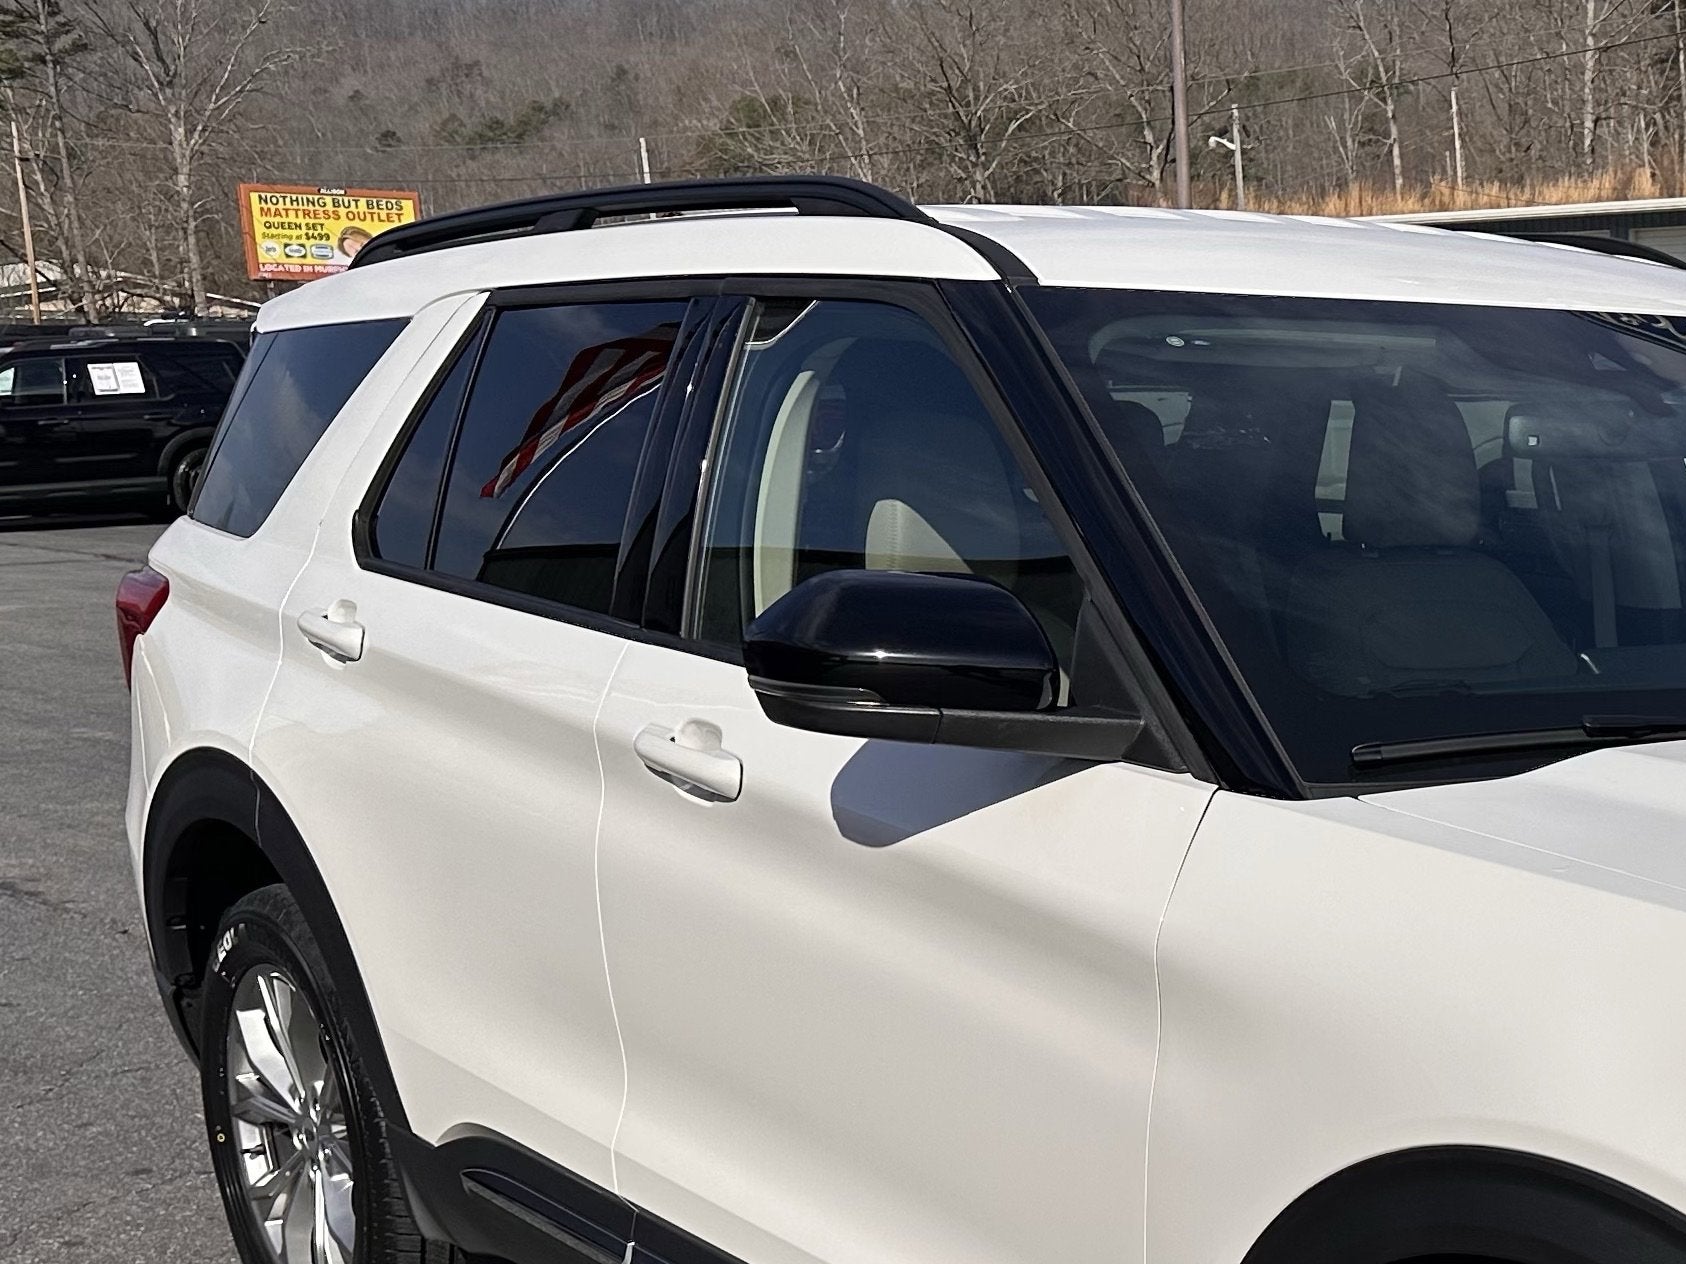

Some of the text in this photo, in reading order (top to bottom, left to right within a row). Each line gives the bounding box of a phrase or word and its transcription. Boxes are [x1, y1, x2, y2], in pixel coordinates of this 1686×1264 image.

[258, 194, 404, 211] NOTHING BUT BEDS
[260, 207, 404, 223] MATTRESS OUTLET
[264, 221, 325, 231] QUEEN SET
[259, 264, 302, 272] LOCATED
